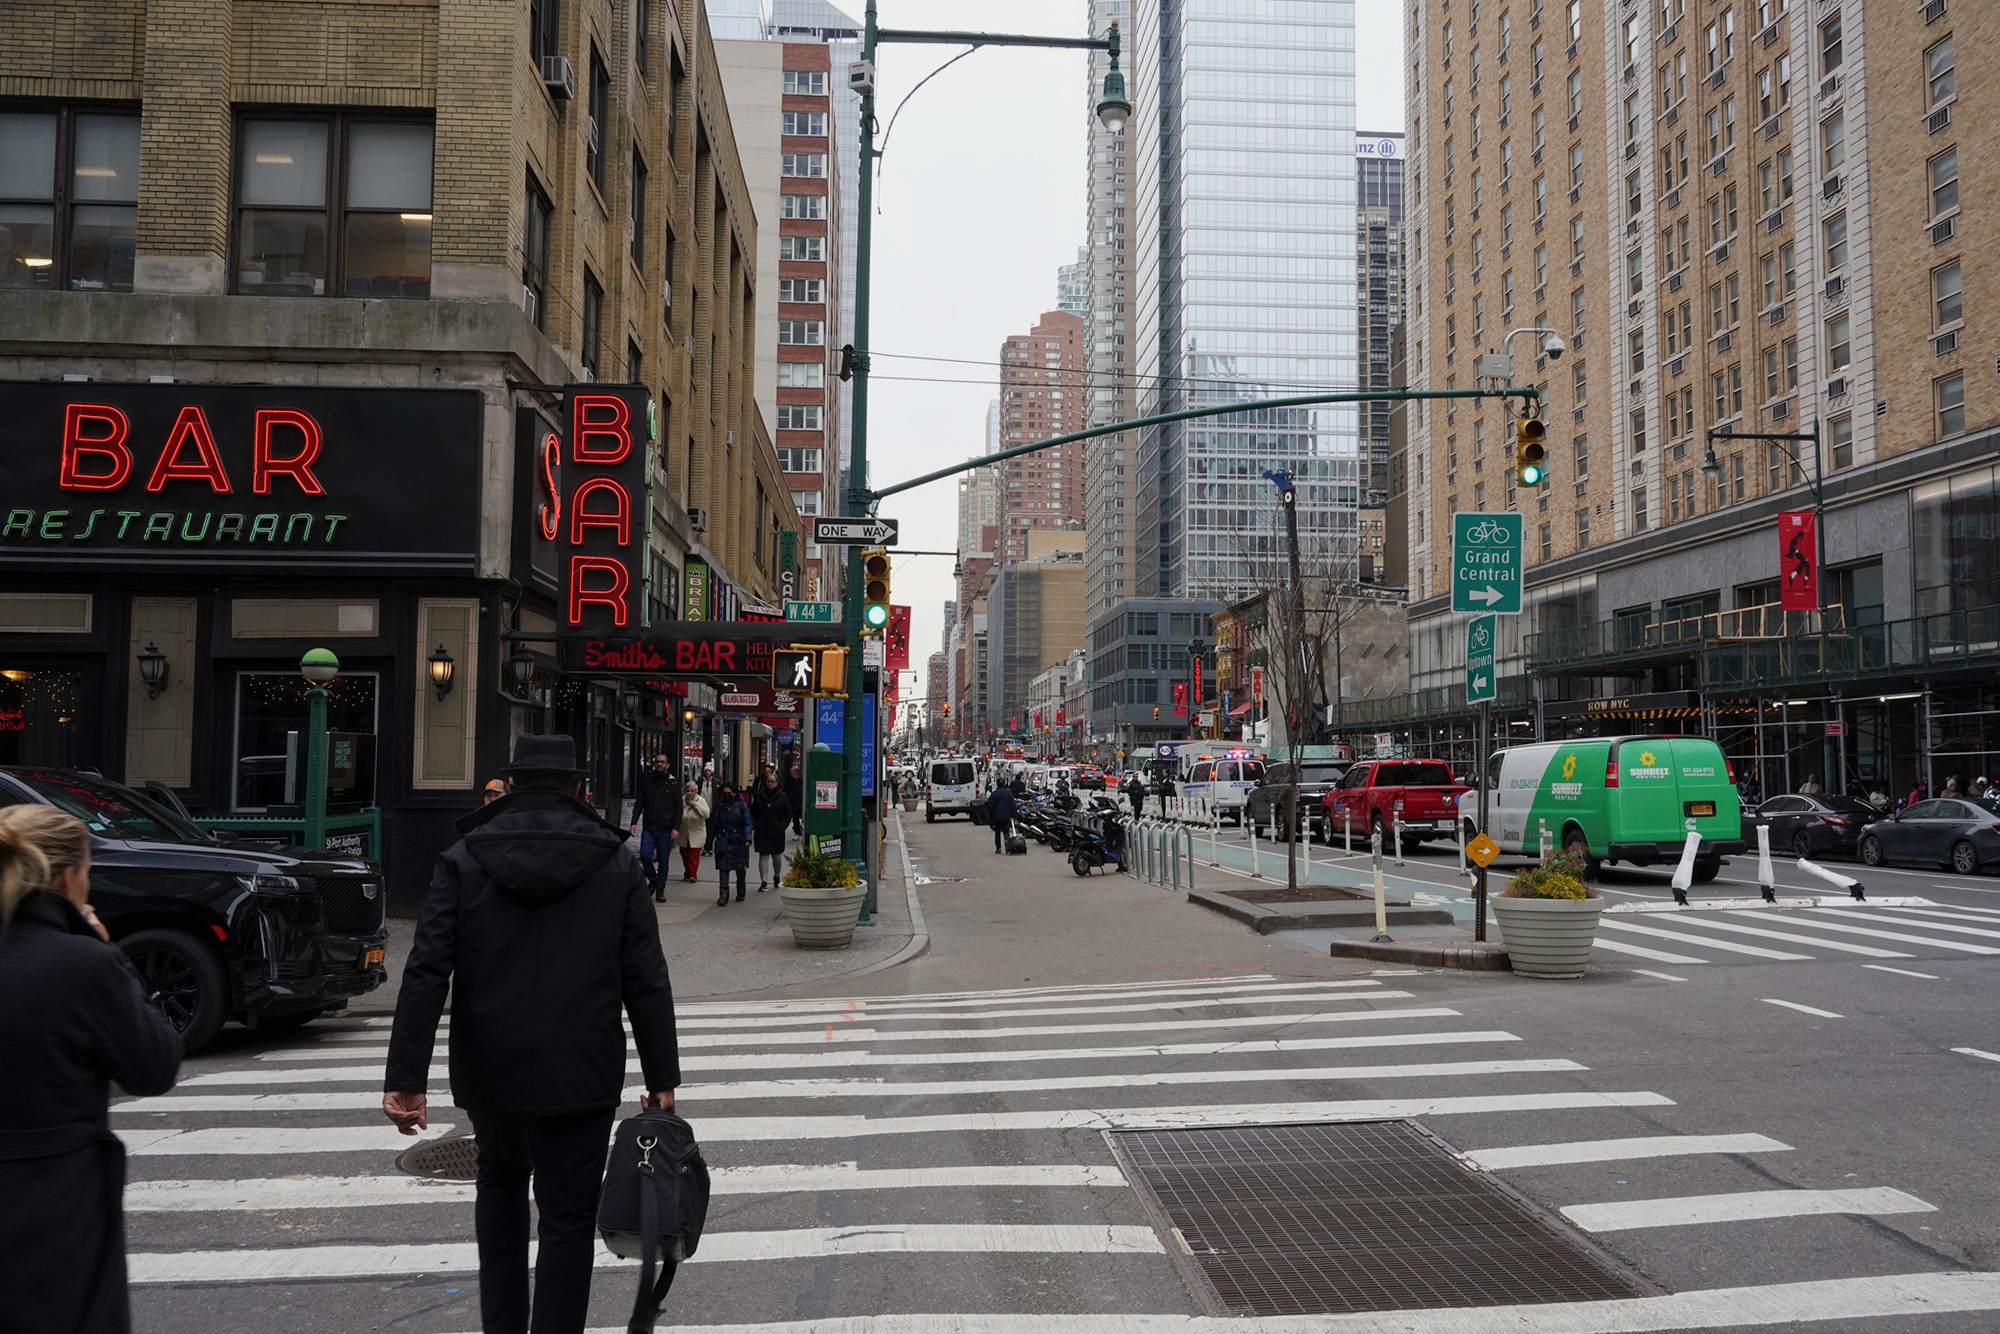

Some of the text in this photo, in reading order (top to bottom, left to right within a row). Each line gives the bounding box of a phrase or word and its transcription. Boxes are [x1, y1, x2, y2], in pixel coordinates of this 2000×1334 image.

[60, 403, 328, 495] BAR
[569, 394, 633, 627] BAR
[2, 509, 349, 544] RESTAURANT
[821, 526, 888, 538] ONE WAY
[1465, 550, 1510, 564] Grand
[1459, 567, 1515, 581] Central
[743, 605, 782, 616] TIMES SQUARE
[789, 604, 798, 619] W
[801, 605, 815, 619] 44
[819, 604, 828, 613] ST
[585, 640, 735, 670] Smith's BAR
[746, 658, 773, 670] KITC
[1468, 654, 1492, 671] Uptown
[1588, 699, 1630, 711] ROW NYC
[820, 711, 843, 724] 44°
[1630, 767, 1670, 776] SUNBELT
[1552, 783, 1582, 795] SUNBELT
[1503, 829, 1519, 840] Service
